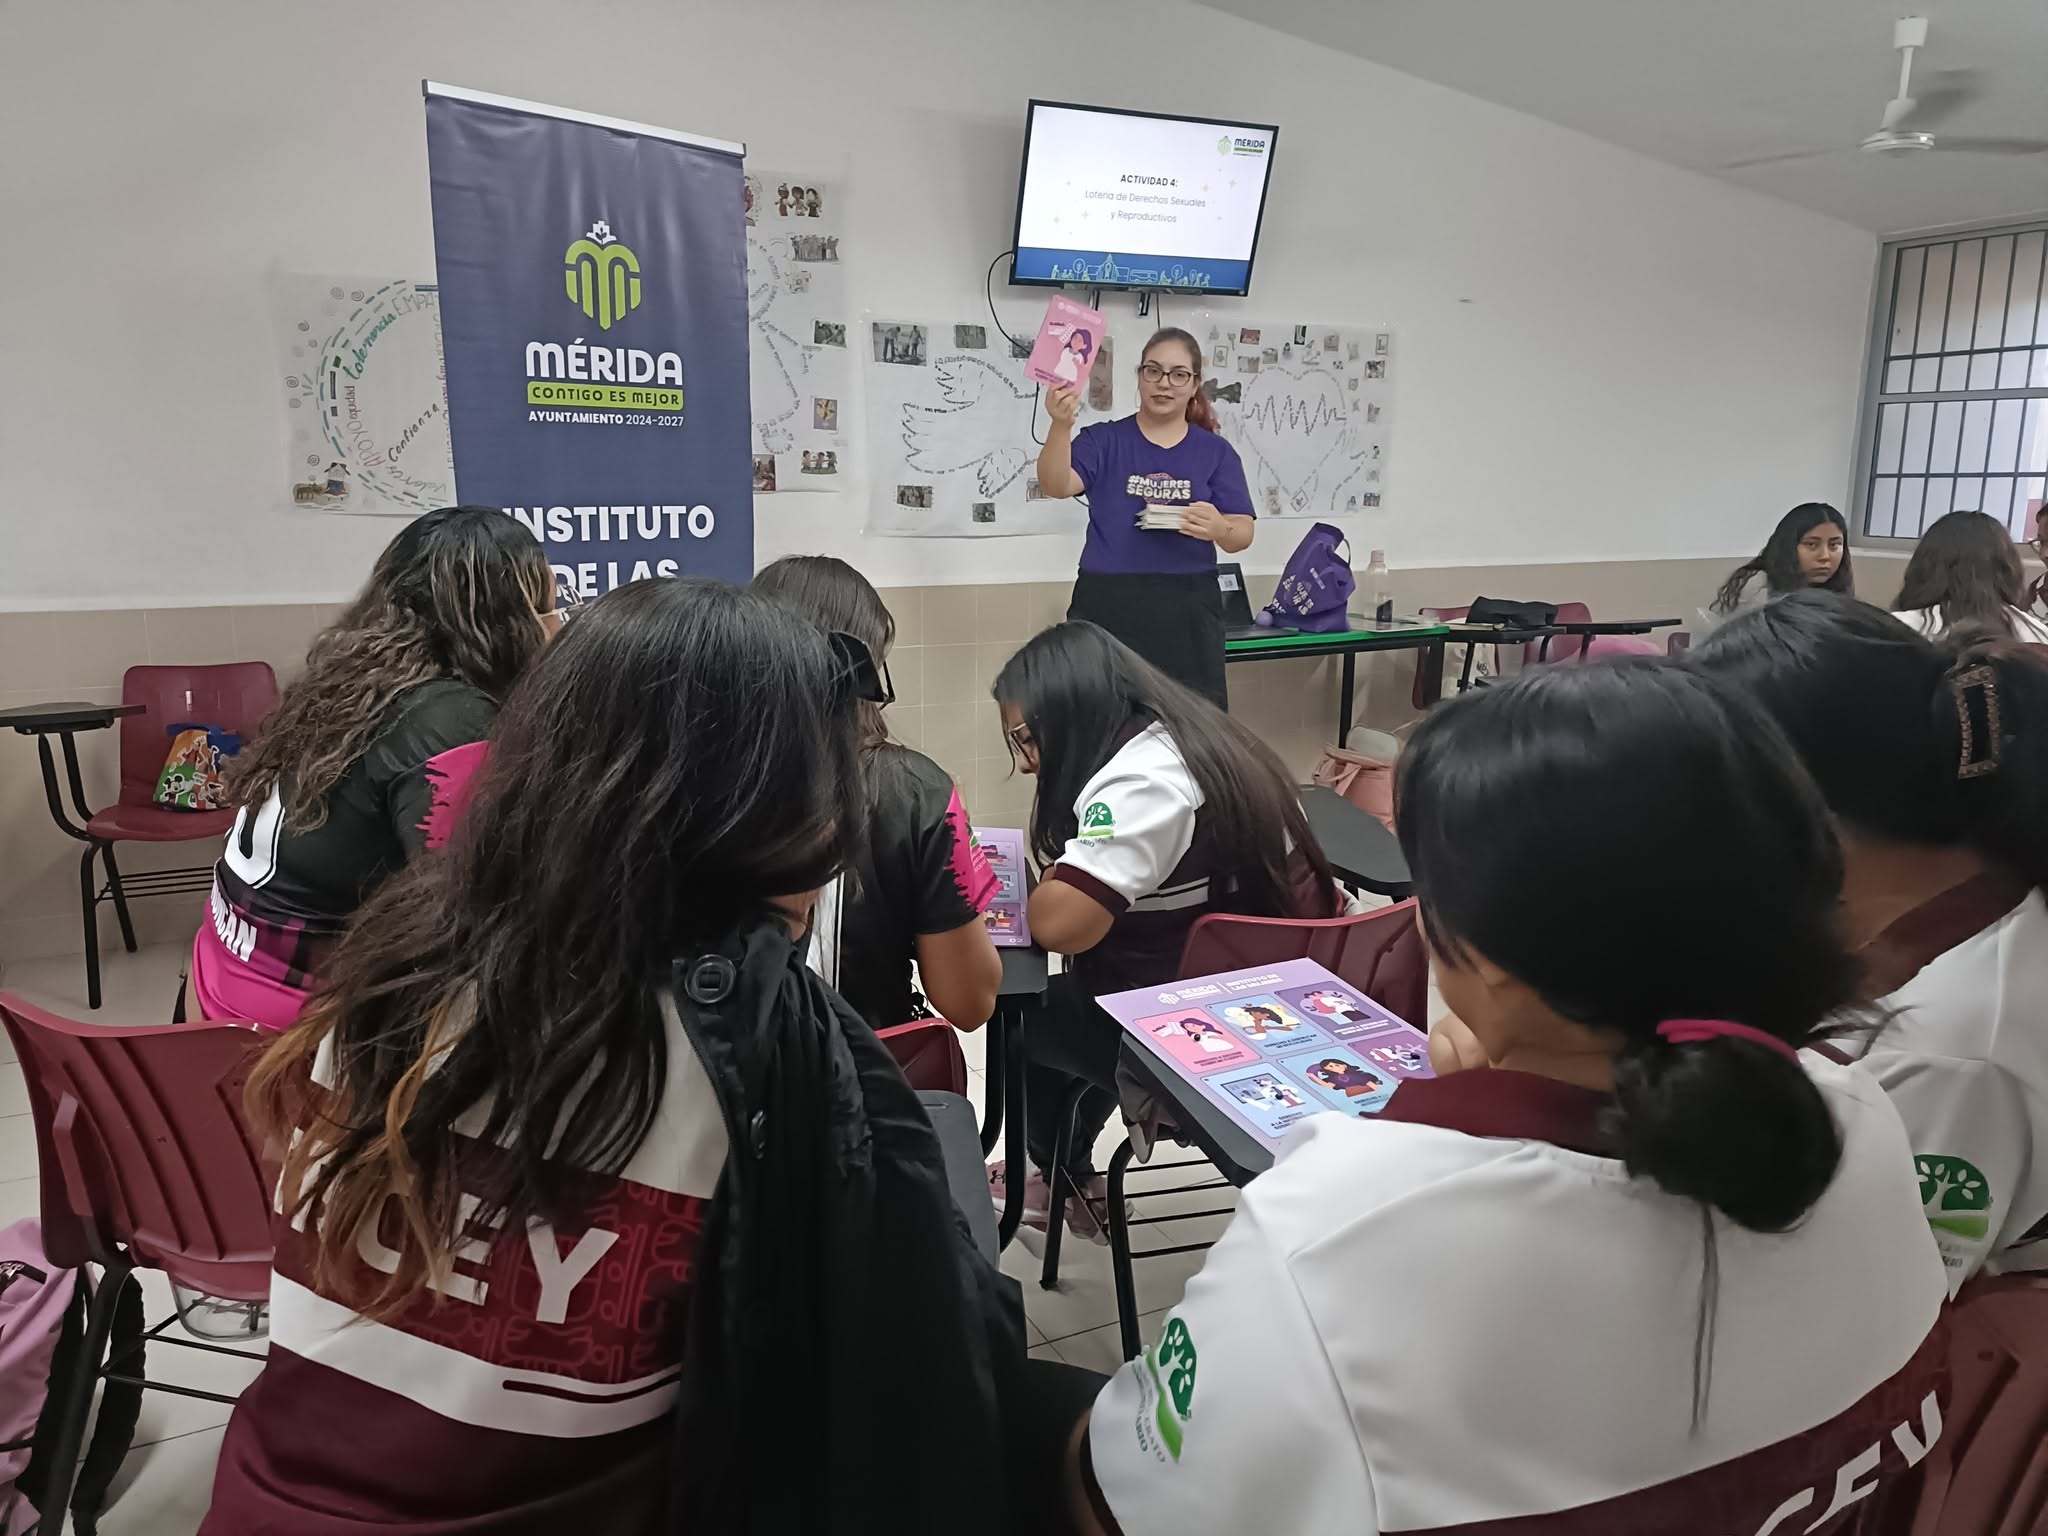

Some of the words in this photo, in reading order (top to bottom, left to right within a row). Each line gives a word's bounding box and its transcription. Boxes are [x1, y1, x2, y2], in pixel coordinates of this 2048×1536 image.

[1120, 173, 1168, 187] ACTIVIDAD
[1170, 178, 1179, 188] 4:
[1116, 192, 1127, 202] de
[1129, 193, 1169, 205] Derechos
[1171, 196, 1207, 208] Sexuales
[1111, 211, 1116, 220] y
[1118, 209, 1177, 223] Reproductivos
[525, 337, 683, 386] MÉRIDA
[531, 385, 603, 402] CONTIGO
[609, 390, 627, 403] ES
[632, 391, 680, 407] MEJOR
[528, 410, 624, 424] AYUNTAMIENTO
[625, 414, 684, 427] 2024-2027
[388, 403, 440, 463] Confianza
[1128, 475, 1191, 489] #MUJERES
[1126, 483, 1191, 500] SEGURAS
[549, 562, 598, 598] DE
